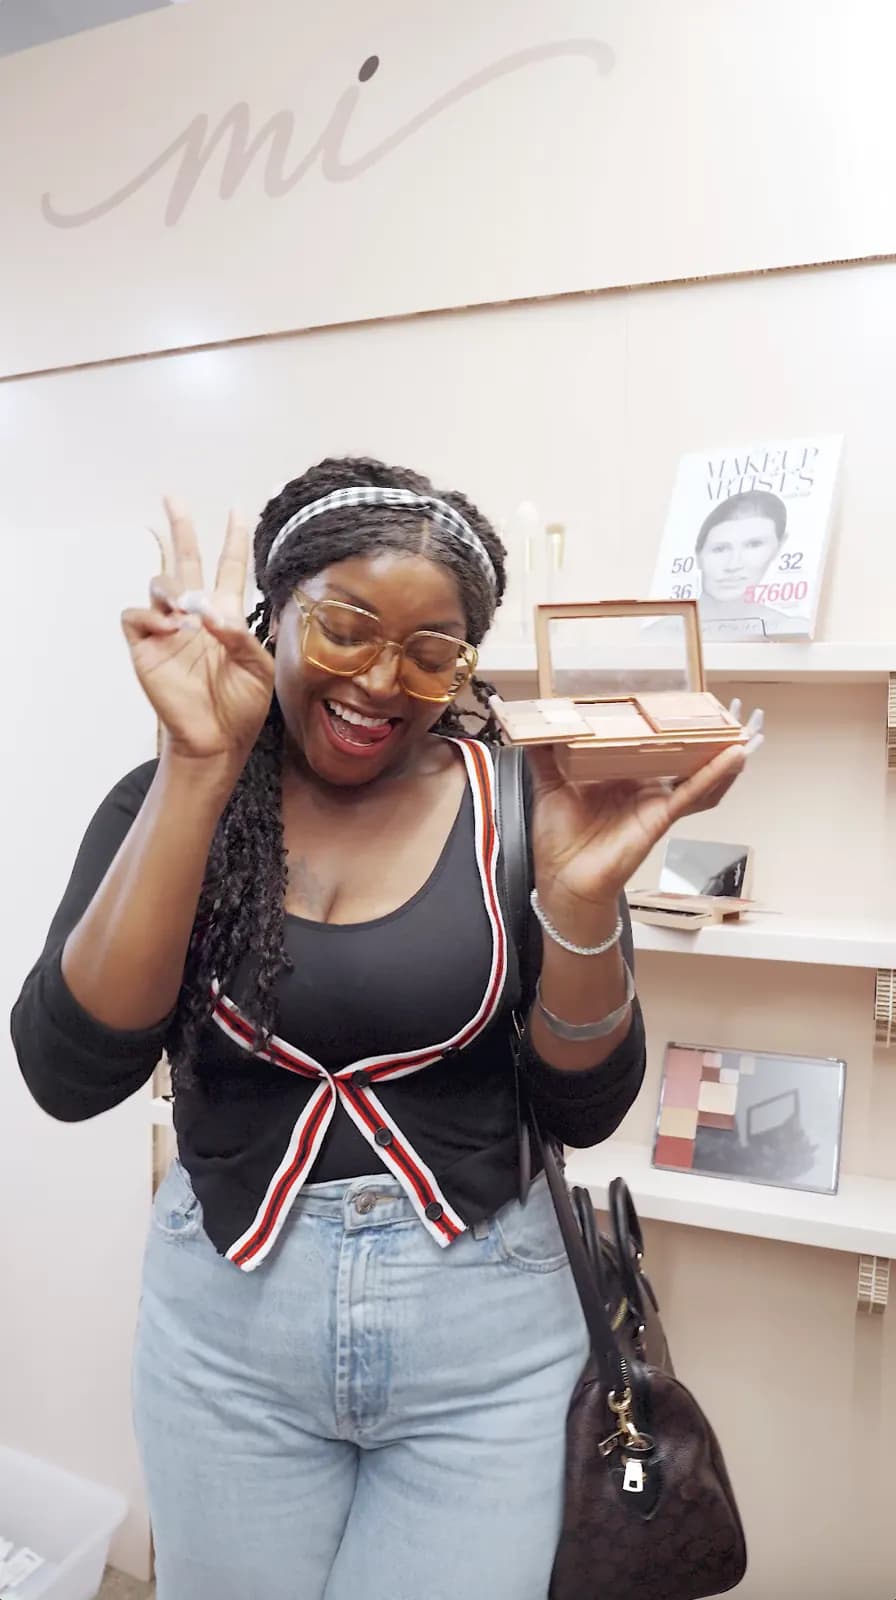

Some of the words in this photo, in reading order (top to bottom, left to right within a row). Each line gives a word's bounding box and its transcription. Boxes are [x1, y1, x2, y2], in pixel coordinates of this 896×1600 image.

[41, 38, 616, 228] mi
[707, 447, 819, 478] MAKEUP
[671, 556, 694, 574] 50
[778, 552, 804, 571] 32
[670, 583, 692, 599] 36
